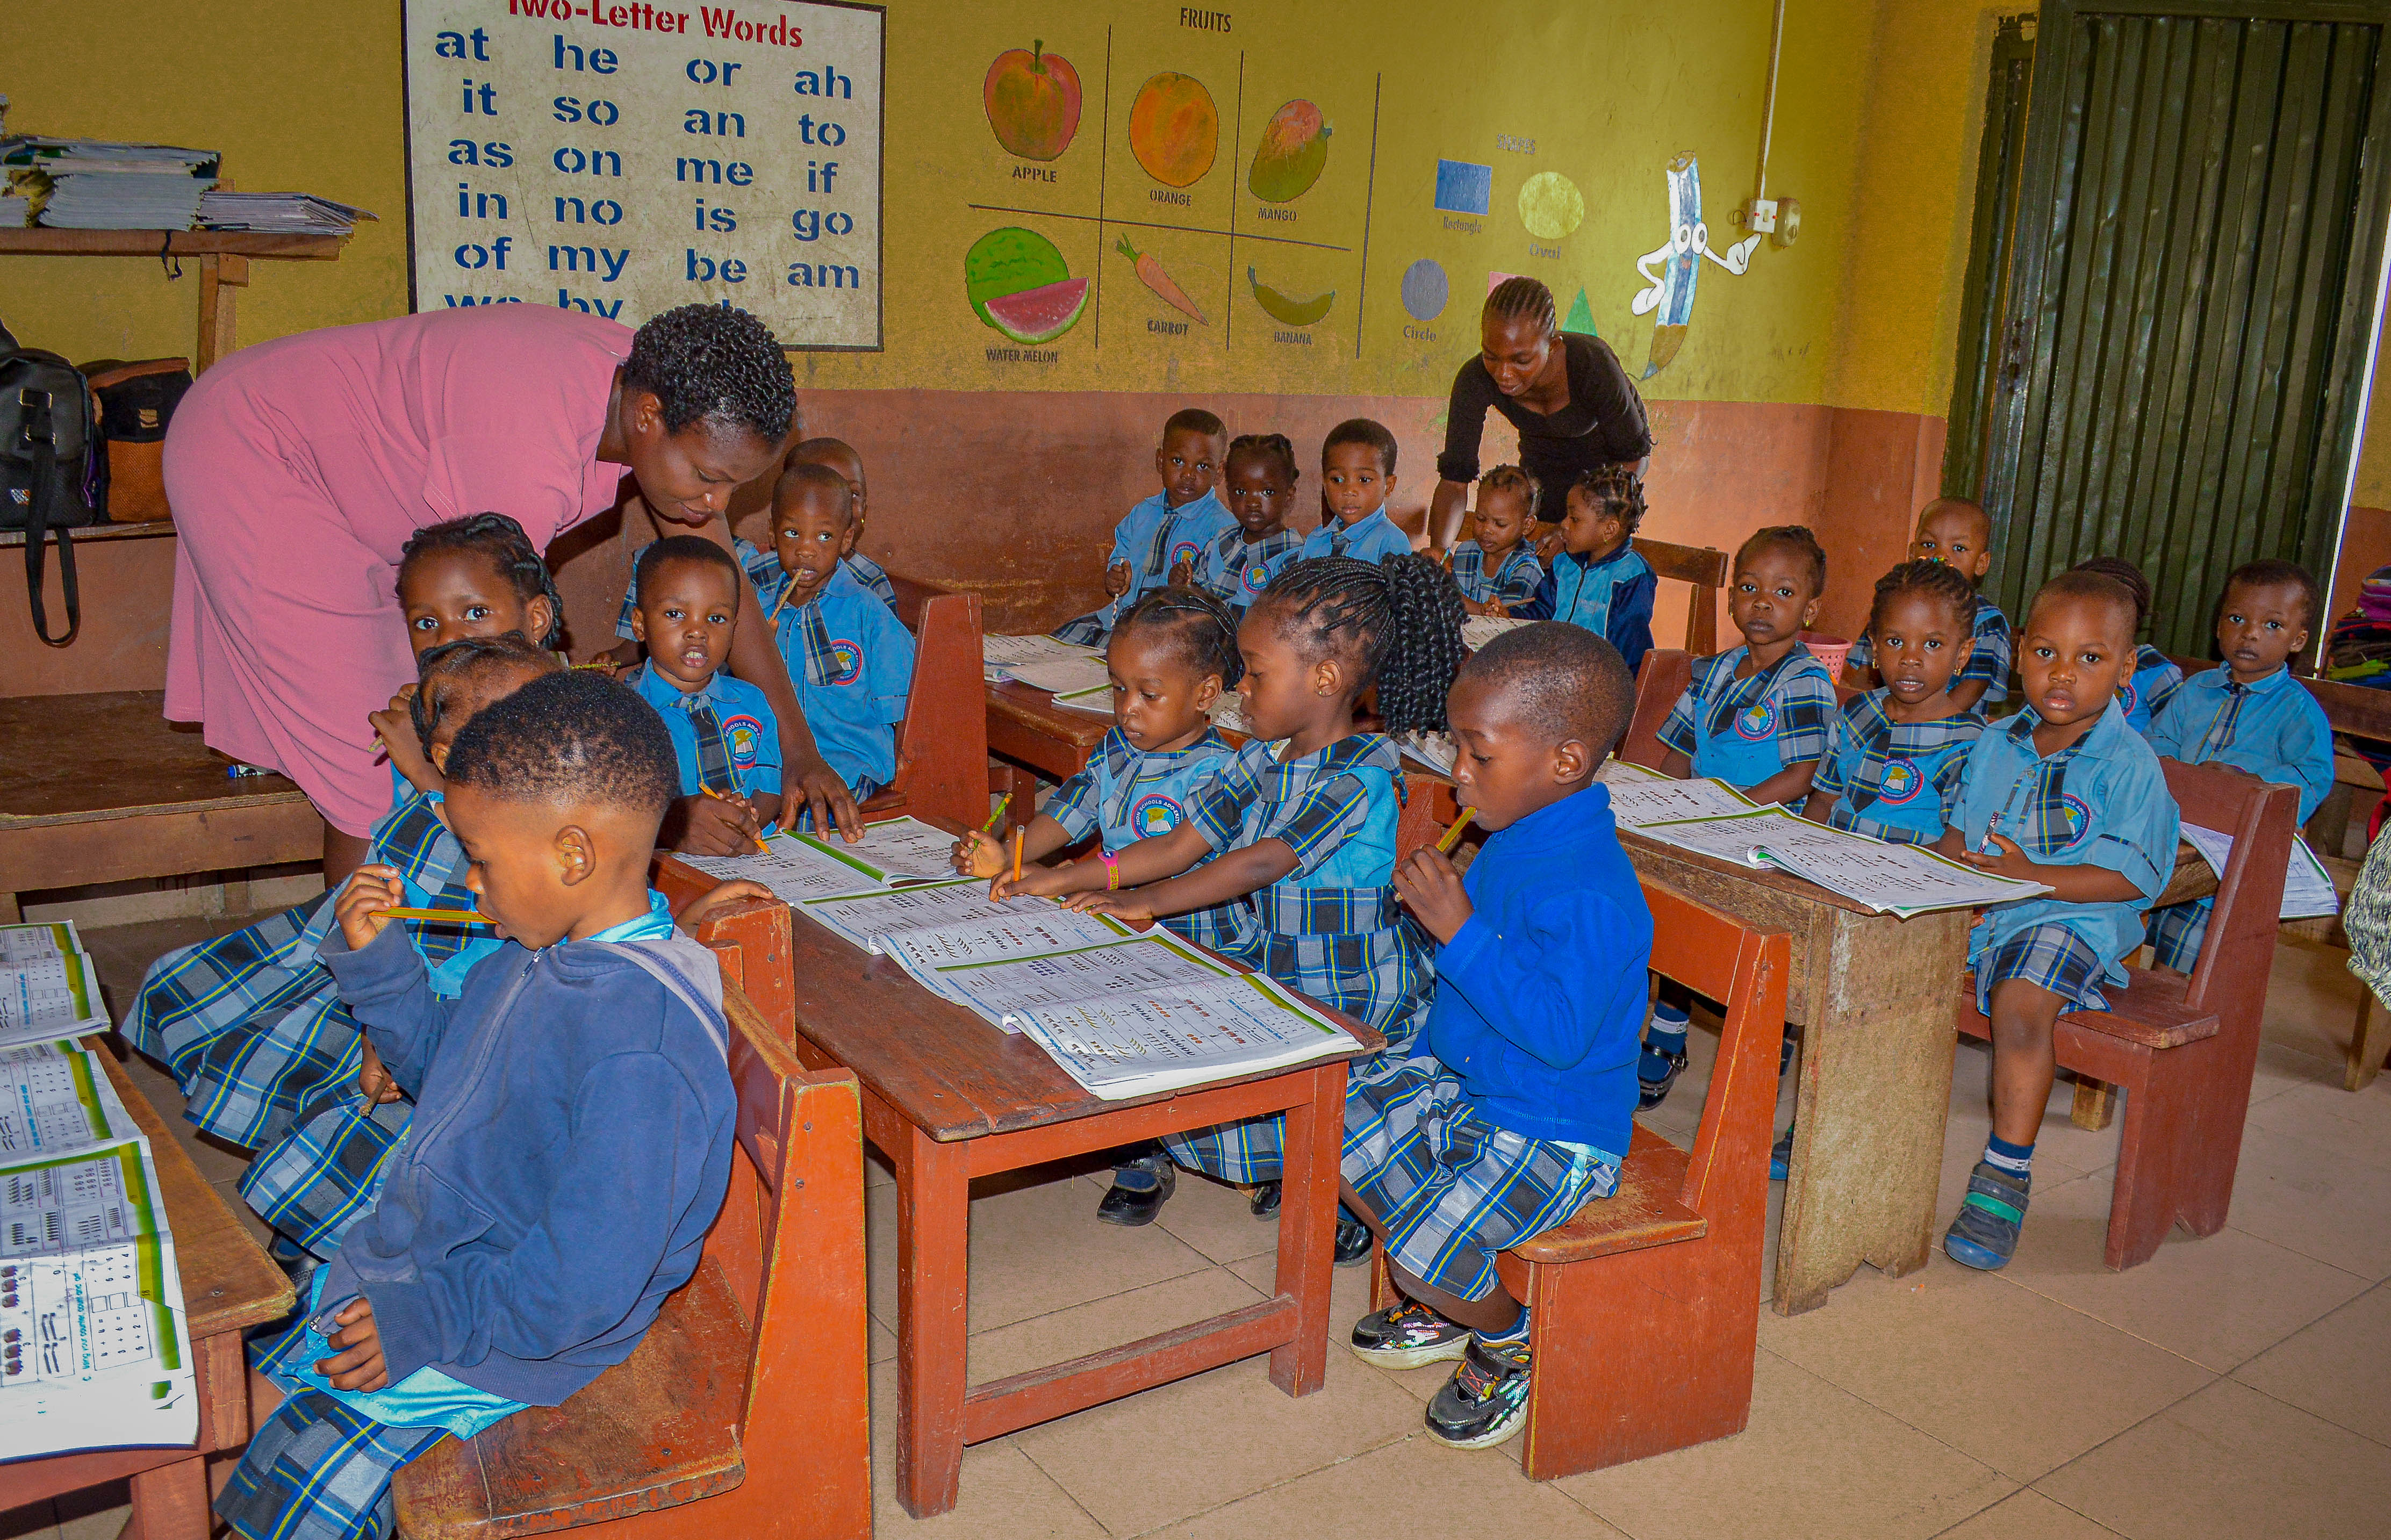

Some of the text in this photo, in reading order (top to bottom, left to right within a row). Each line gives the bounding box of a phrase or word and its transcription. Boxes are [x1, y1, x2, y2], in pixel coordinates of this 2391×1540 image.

[700, 6, 803, 48] Words
[1180, 7, 1232, 33] FRUITS
[435, 27, 852, 99] at he or ah
[463, 78, 845, 146] it so an to
[1496, 133, 1535, 155] SHAPES
[448, 139, 838, 193] as on me if
[1011, 166, 1058, 183] APPLE
[1150, 189, 1191, 206] ORANGE
[459, 182, 853, 241] in no is go
[1258, 207, 1297, 222] MANGO
[1443, 216, 1482, 236] Rectangle
[1529, 243, 1561, 260] Oval
[454, 236, 859, 288] of my be am
[1147, 319, 1189, 336] CARROT
[1403, 325, 1437, 342] Circle
[1274, 331, 1312, 345] BANANA
[986, 348, 1058, 363] WATER MELON
[1883, 759, 1909, 768] SCHOOLS
[1139, 800, 1162, 812] SCHOOLS
[1163, 801, 1180, 824] ADO-EKITI
